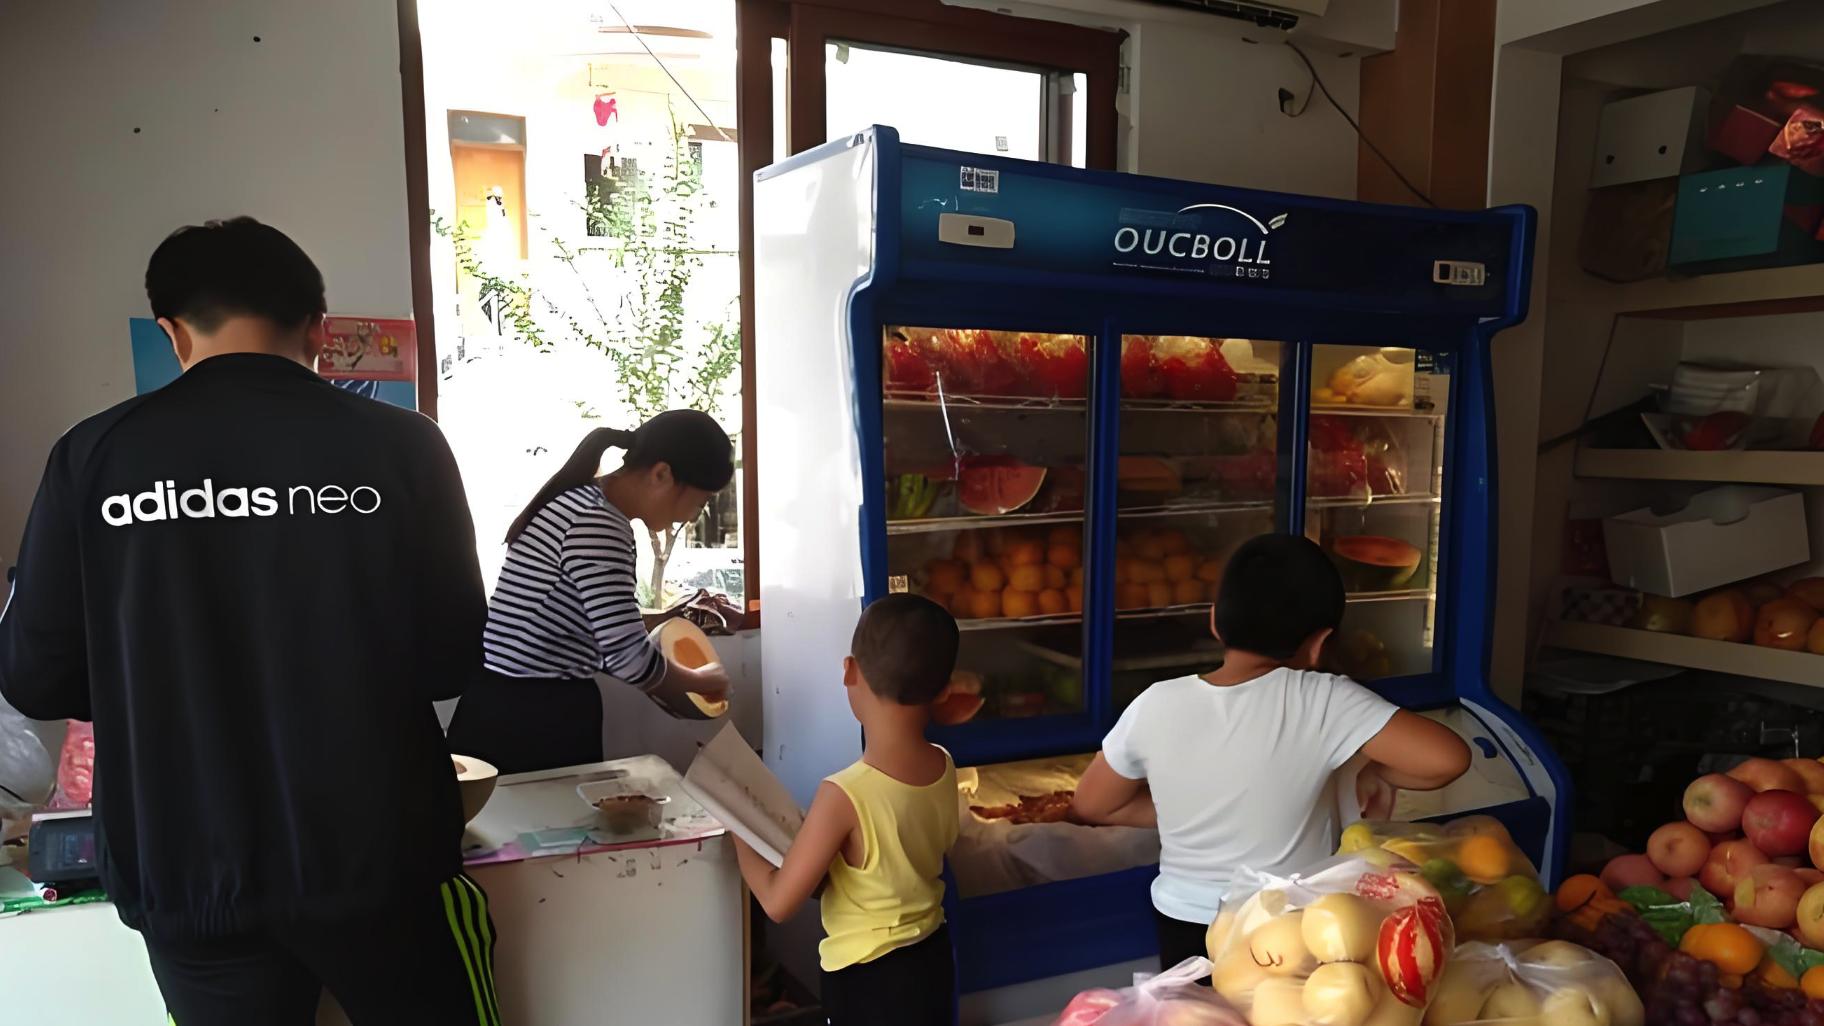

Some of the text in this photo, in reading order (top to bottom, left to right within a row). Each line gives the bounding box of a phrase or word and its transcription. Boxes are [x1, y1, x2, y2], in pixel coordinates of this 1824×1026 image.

[1114, 227, 1271, 264] OUCBOLL
[101, 478, 382, 527] adidas neo
